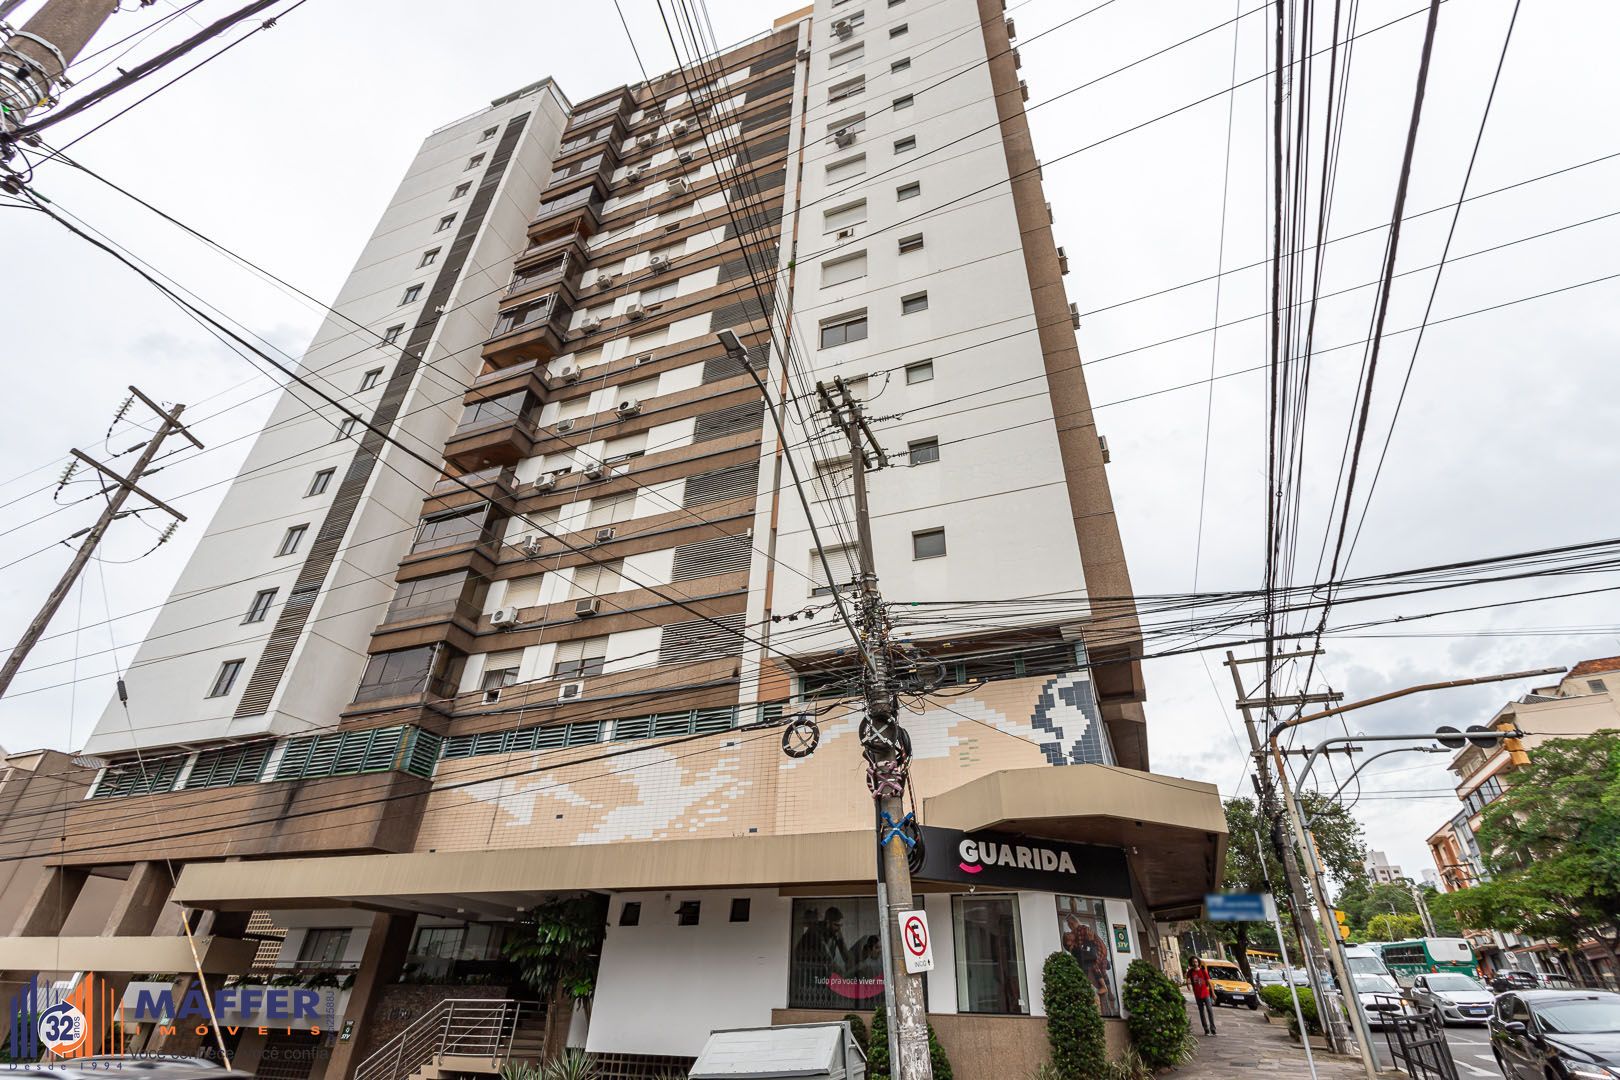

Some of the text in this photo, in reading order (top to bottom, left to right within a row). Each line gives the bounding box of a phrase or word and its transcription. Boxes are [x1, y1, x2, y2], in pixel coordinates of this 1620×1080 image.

[959, 839, 1077, 874] GUARIDA
[814, 976, 829, 985] Tudo
[843, 977, 858, 985] você
[859, 977, 875, 985] viver
